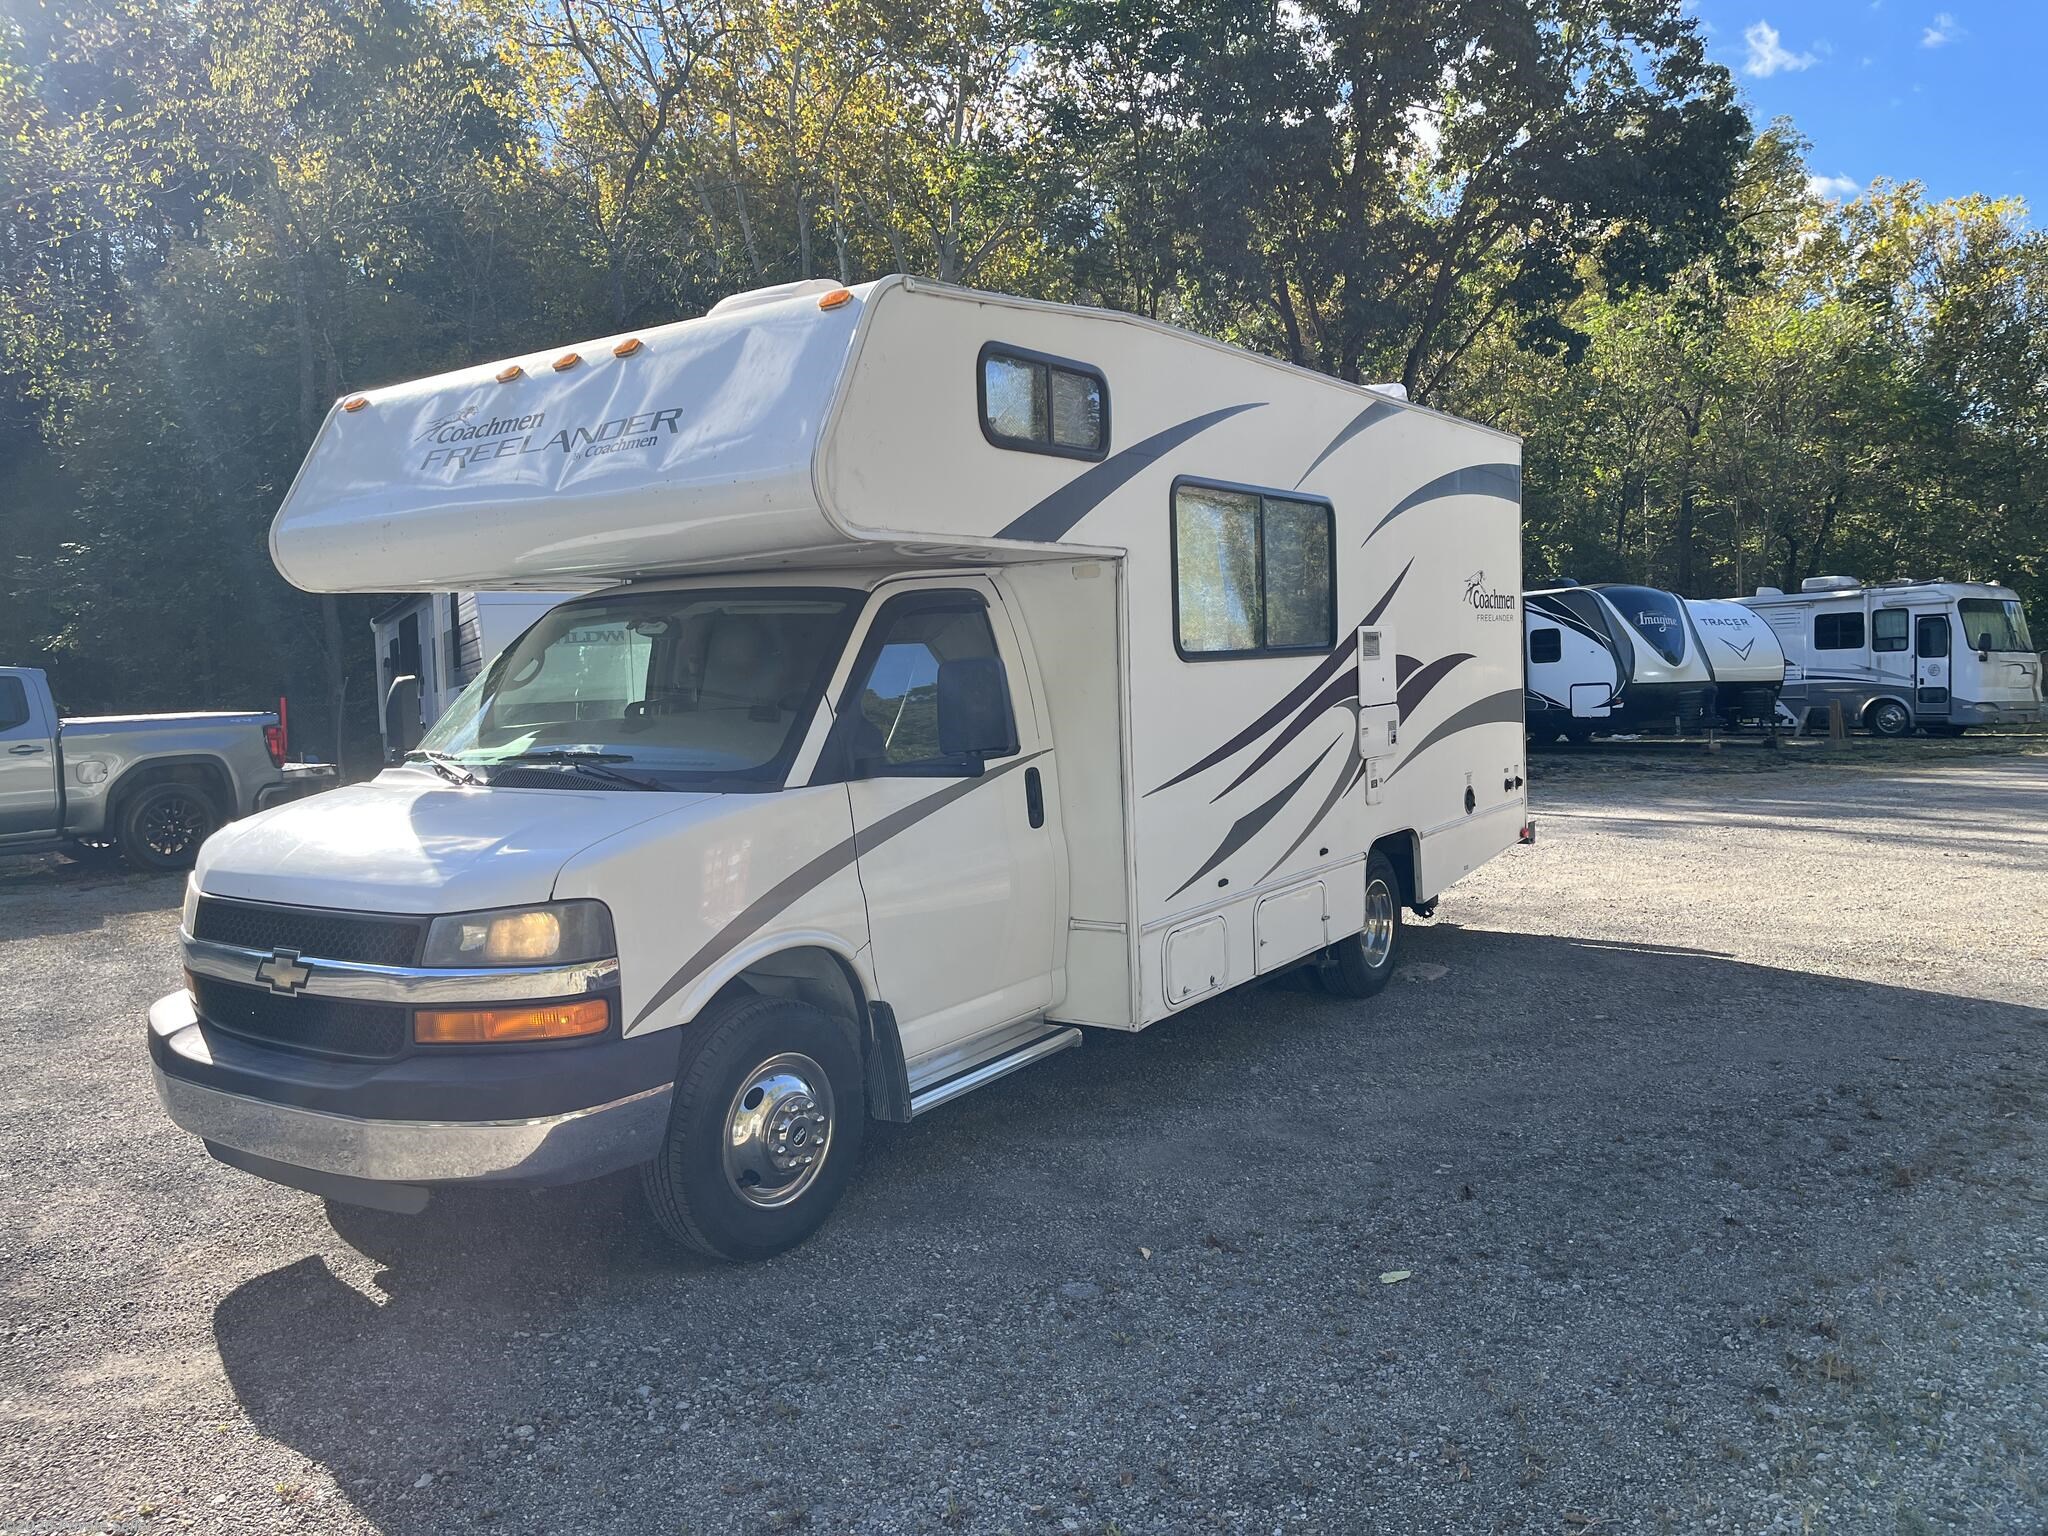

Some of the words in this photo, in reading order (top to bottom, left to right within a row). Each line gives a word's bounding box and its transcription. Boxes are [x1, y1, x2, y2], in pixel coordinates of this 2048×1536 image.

[437, 411, 546, 444] Coachmen
[420, 408, 684, 471] FREELANDER
[585, 435, 658, 458] Coachmen
[1473, 589, 1515, 610] Coachmen
[1476, 614, 1514, 622] FREELANDER
[1639, 611, 1678, 633] Imagine
[1700, 618, 1750, 627] TRACER
